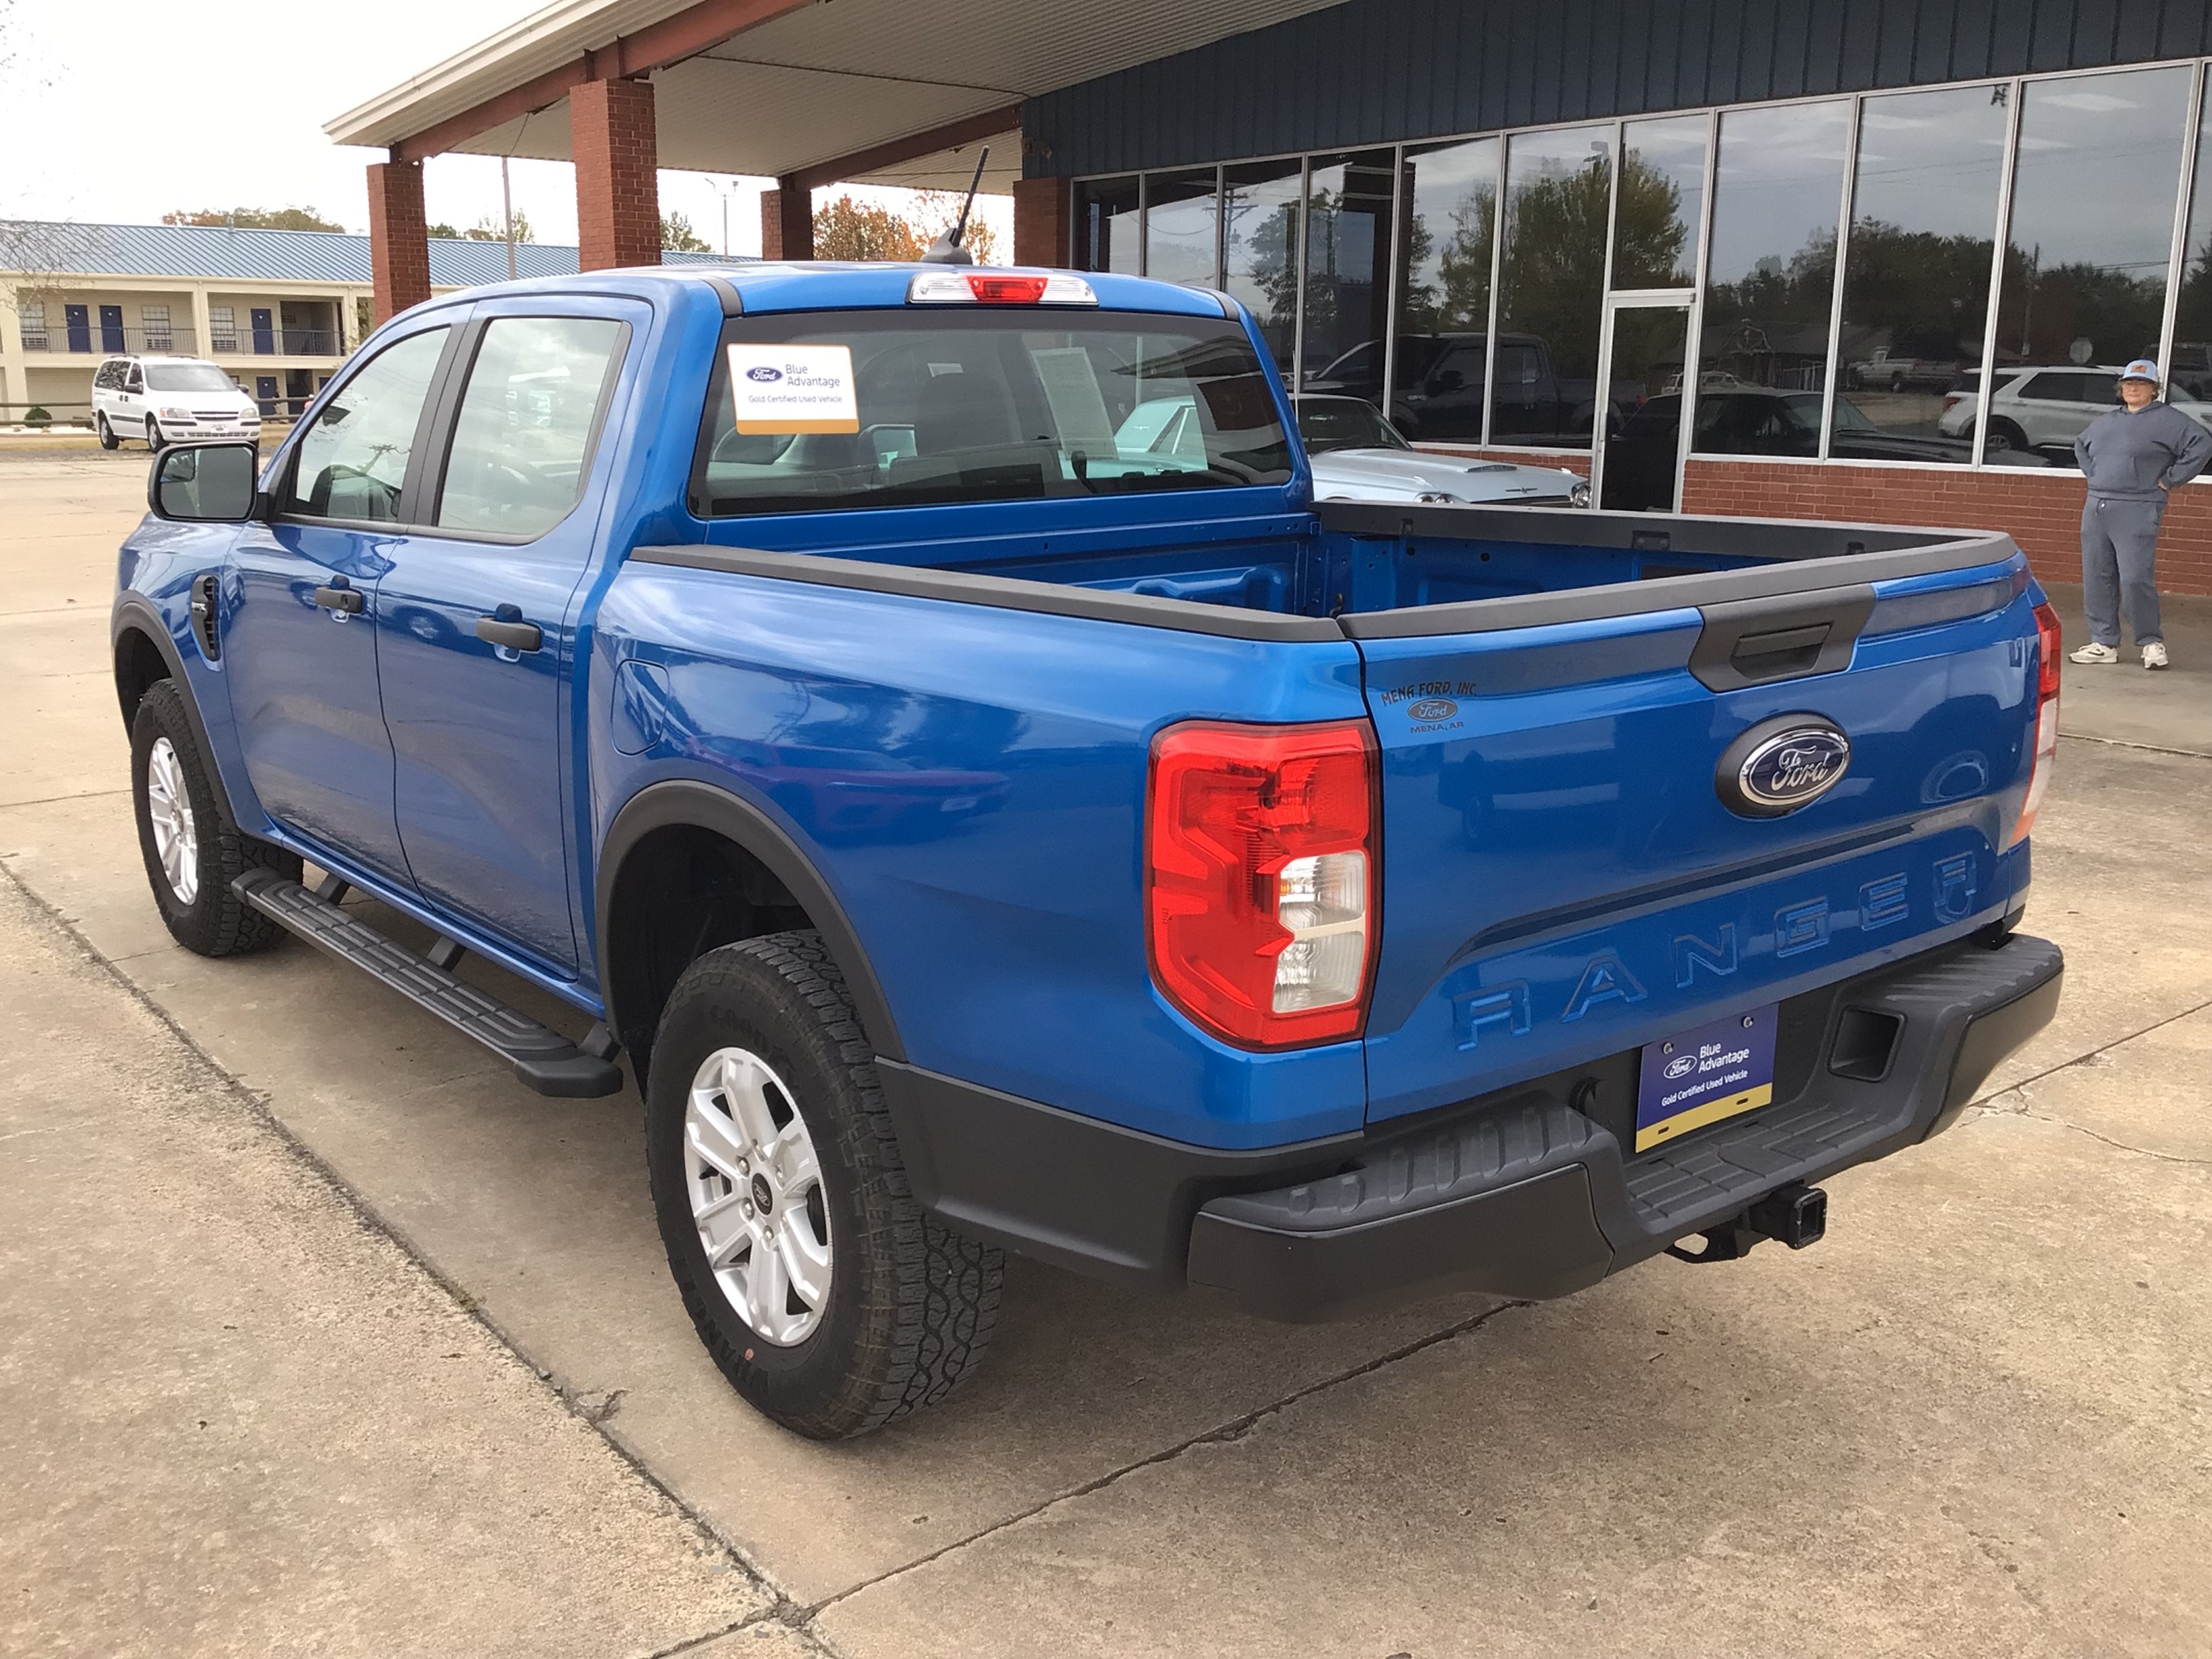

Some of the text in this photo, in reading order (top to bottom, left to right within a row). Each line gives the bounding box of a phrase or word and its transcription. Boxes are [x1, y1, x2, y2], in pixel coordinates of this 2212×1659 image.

[752, 367, 777, 381] Ford
[785, 364, 808, 374] Blue
[787, 376, 840, 388] Advantage
[748, 395, 765, 403] Gold
[767, 395, 796, 403] Certified
[1380, 684, 1415, 707] MENA
[1418, 701, 1448, 718] Ford
[1410, 721, 1465, 734] MENA, AR
[1769, 744, 1831, 792] Ford
[1452, 851, 1978, 1052] RANGER
[1699, 1043, 1721, 1059] Blue
[1668, 1058, 1692, 1077] Ford
[1698, 1048, 1750, 1073] Advantage
[1661, 1069, 1748, 1107] Gold Certified Used Vehicle
